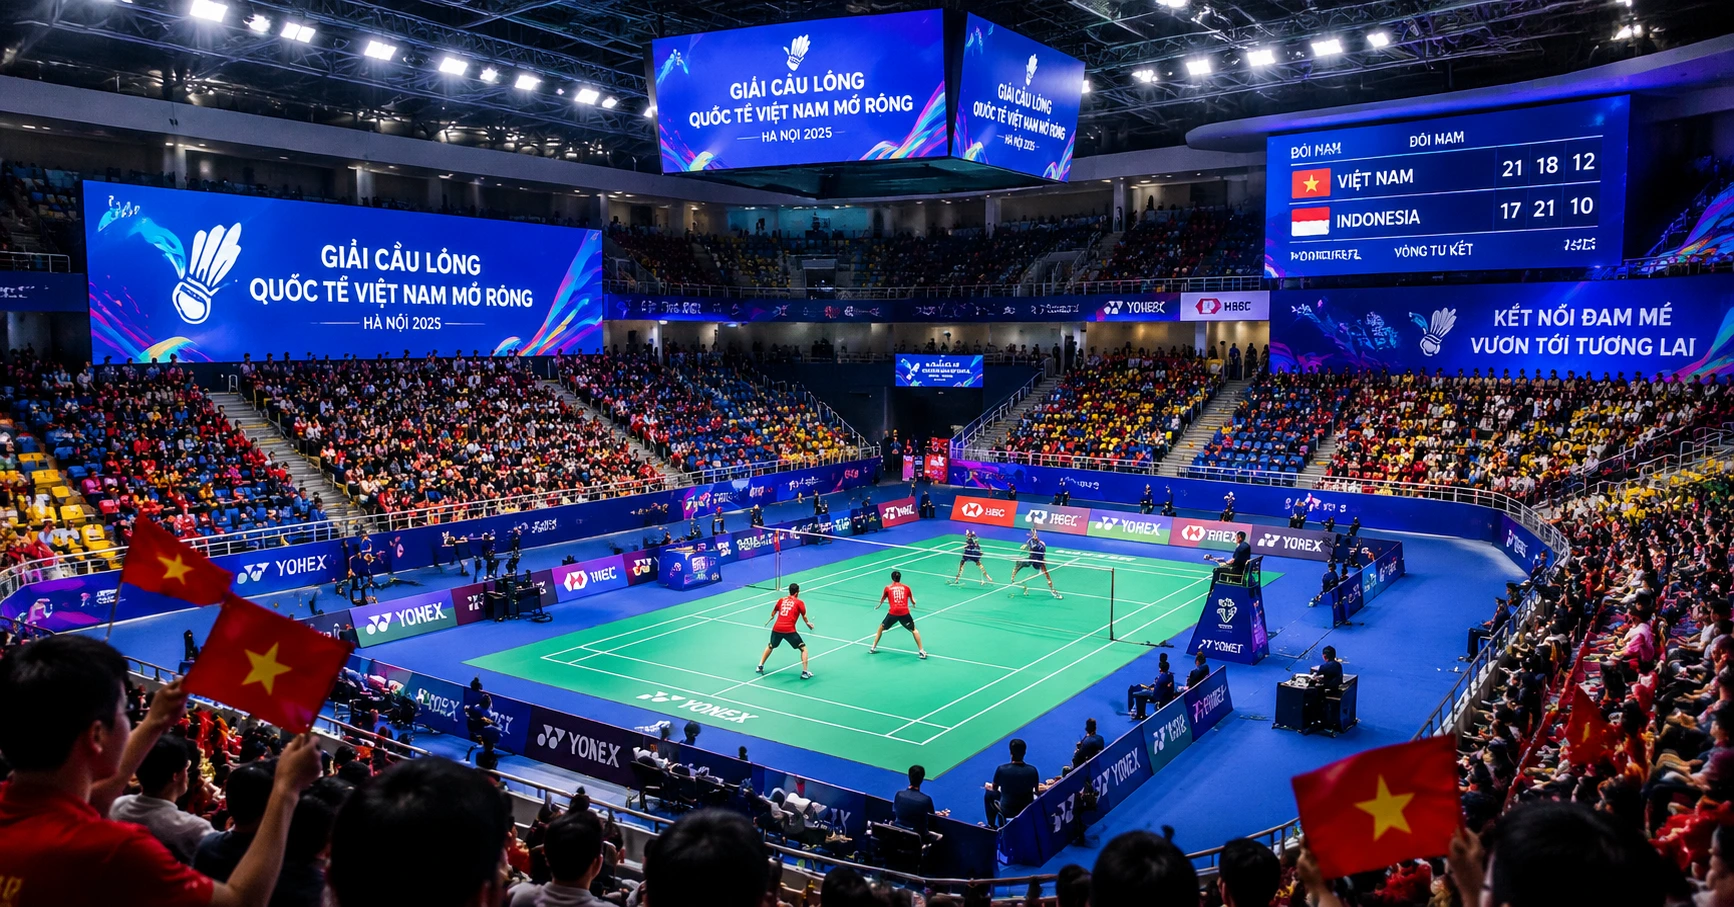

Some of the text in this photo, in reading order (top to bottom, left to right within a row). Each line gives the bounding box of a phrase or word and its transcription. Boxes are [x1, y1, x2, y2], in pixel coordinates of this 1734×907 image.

[793, 101, 829, 119] NAM
[803, 127, 832, 140] 2025
[1376, 168, 1414, 186] NAM
[1502, 159, 1522, 177] 21
[1536, 156, 1559, 174] 18
[1572, 152, 1595, 171] 12
[1336, 196, 1594, 229] INDONESIA 17 21 10
[354, 278, 398, 308] VIỆT
[403, 284, 447, 305] NAM
[1581, 307, 1632, 326] ĐAM
[1575, 335, 1653, 356] TƯƠNG
[1659, 337, 1697, 357] LAI
[677, 699, 759, 723] YONEX
[568, 731, 621, 768] YONEX
